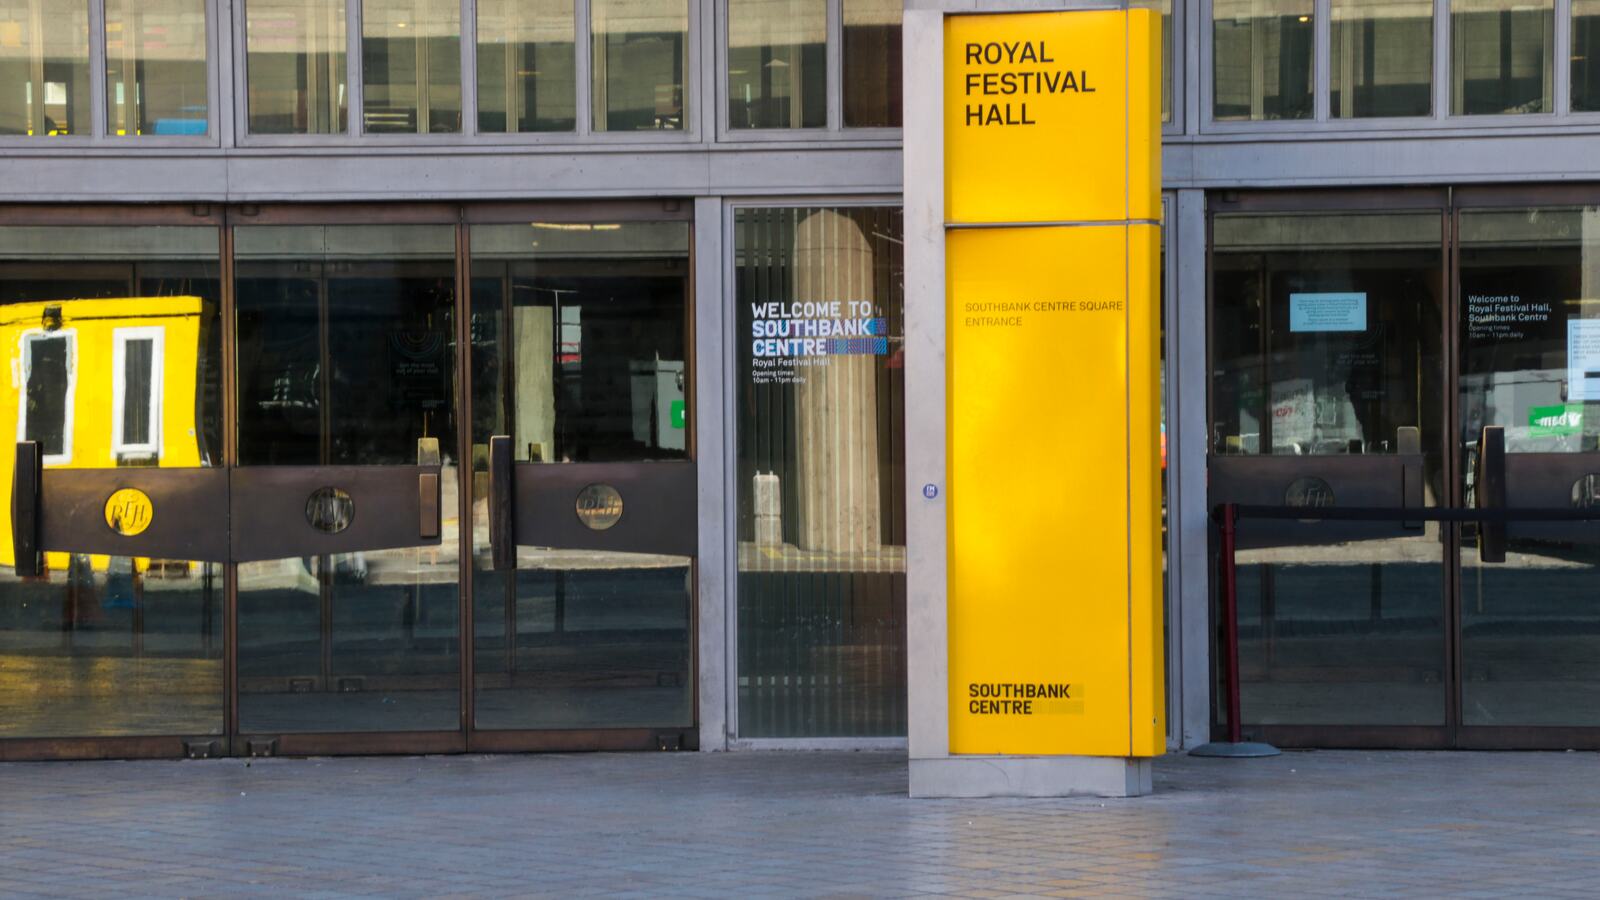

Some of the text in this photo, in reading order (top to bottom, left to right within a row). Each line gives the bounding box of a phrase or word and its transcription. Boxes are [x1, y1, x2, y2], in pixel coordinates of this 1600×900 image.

[966, 41, 1054, 65] ROYAL
[966, 71, 1096, 95] FESTIVAL
[966, 103, 1036, 126] HALL
[965, 301, 1123, 312] SOUTHBANK CENTRE SQUARE
[1468, 295, 1520, 304] Welcome to
[752, 301, 871, 318] WELCOME TO
[1468, 305, 1493, 314] Royal
[1494, 304, 1529, 312] Festival
[965, 317, 1023, 327] ENTRANCE
[1468, 313, 1548, 323] Southbank Centre
[752, 319, 872, 337] SOUTHBANK
[752, 338, 827, 357] CENTRE
[752, 356, 831, 368] Royal Festival Hall
[969, 683, 1071, 699] SOUTHBANK
[969, 700, 1033, 715] CENTRE
